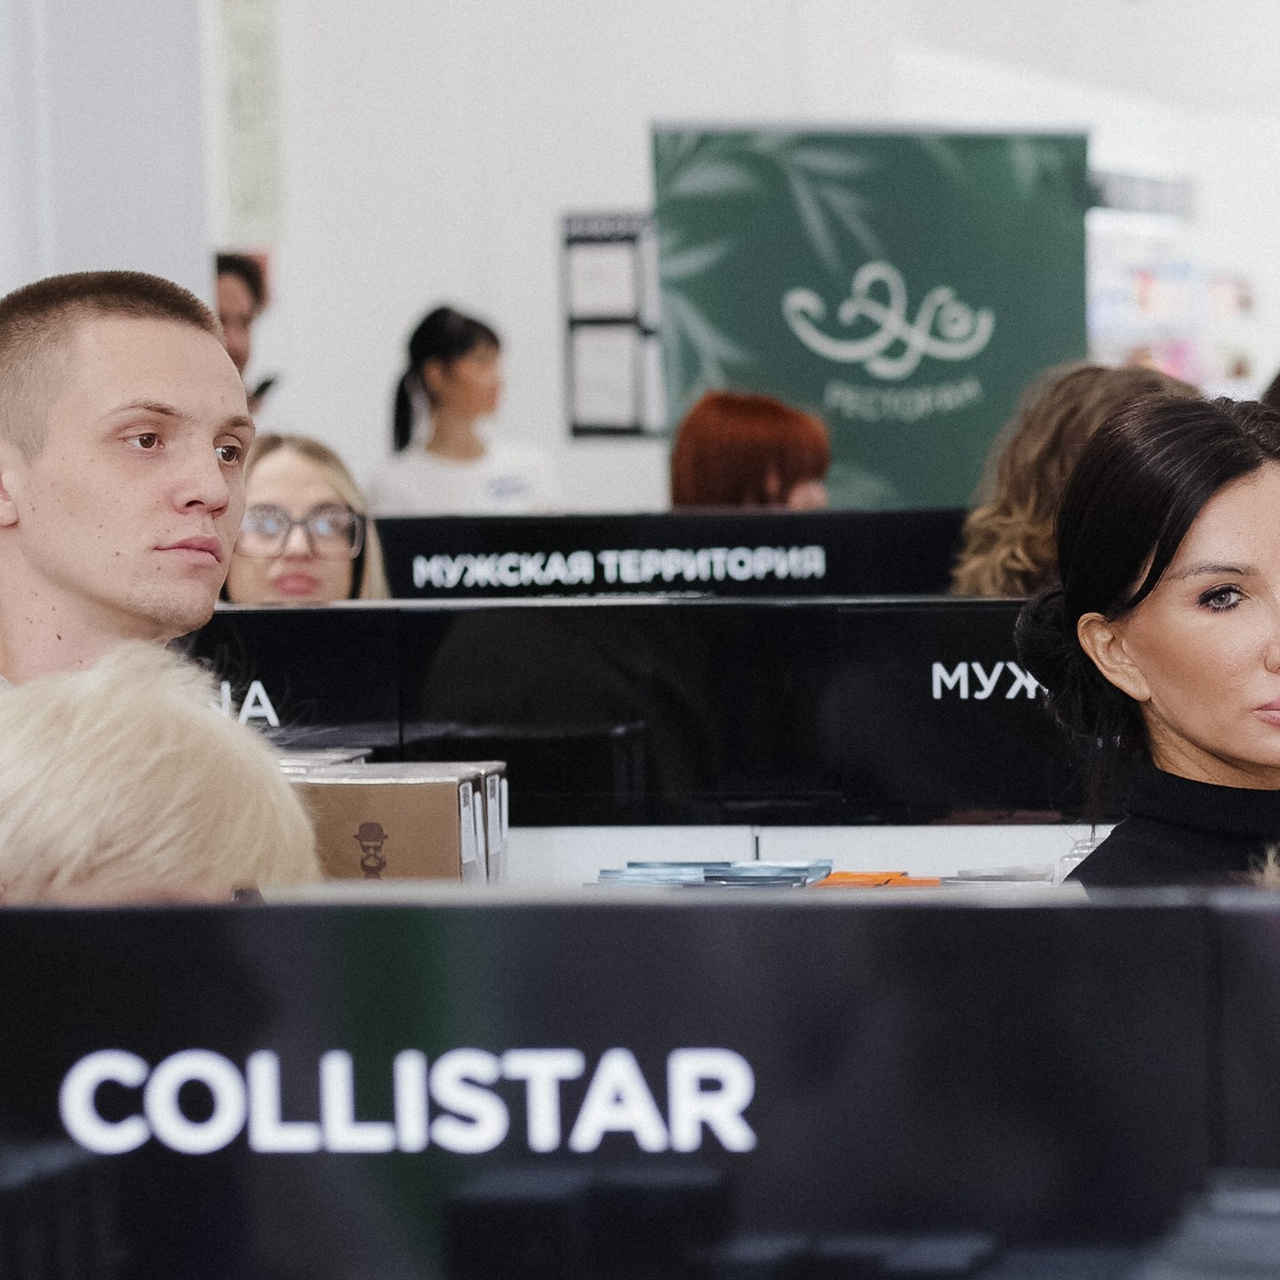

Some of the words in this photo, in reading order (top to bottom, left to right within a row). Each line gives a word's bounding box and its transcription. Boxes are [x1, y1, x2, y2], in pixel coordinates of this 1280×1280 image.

[412, 551, 595, 588] МУЖСКАЯ
[598, 545, 827, 584] ТЕРРИТОРИЯ
[58, 1047, 758, 1156] COLLISTAR
